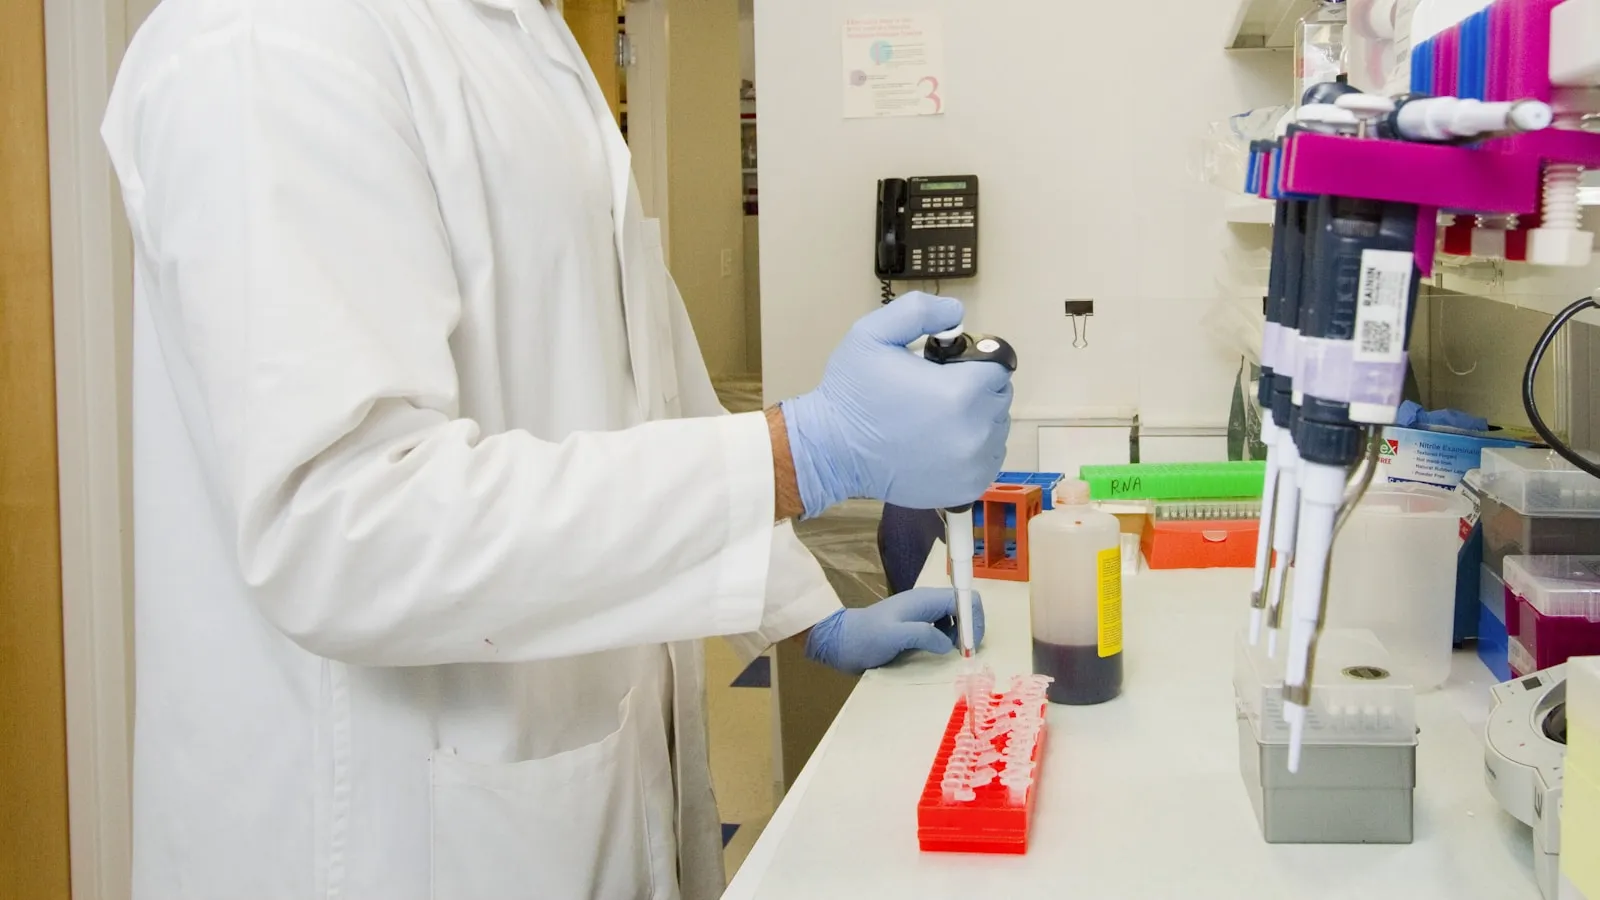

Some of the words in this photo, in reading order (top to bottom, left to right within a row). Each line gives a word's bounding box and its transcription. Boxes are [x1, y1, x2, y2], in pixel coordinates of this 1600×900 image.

[917, 75, 941, 114] 3
[1363, 267, 1376, 306] RAININ
[1419, 441, 1441, 450] Nitrile
[1111, 476, 1141, 495] RNA
